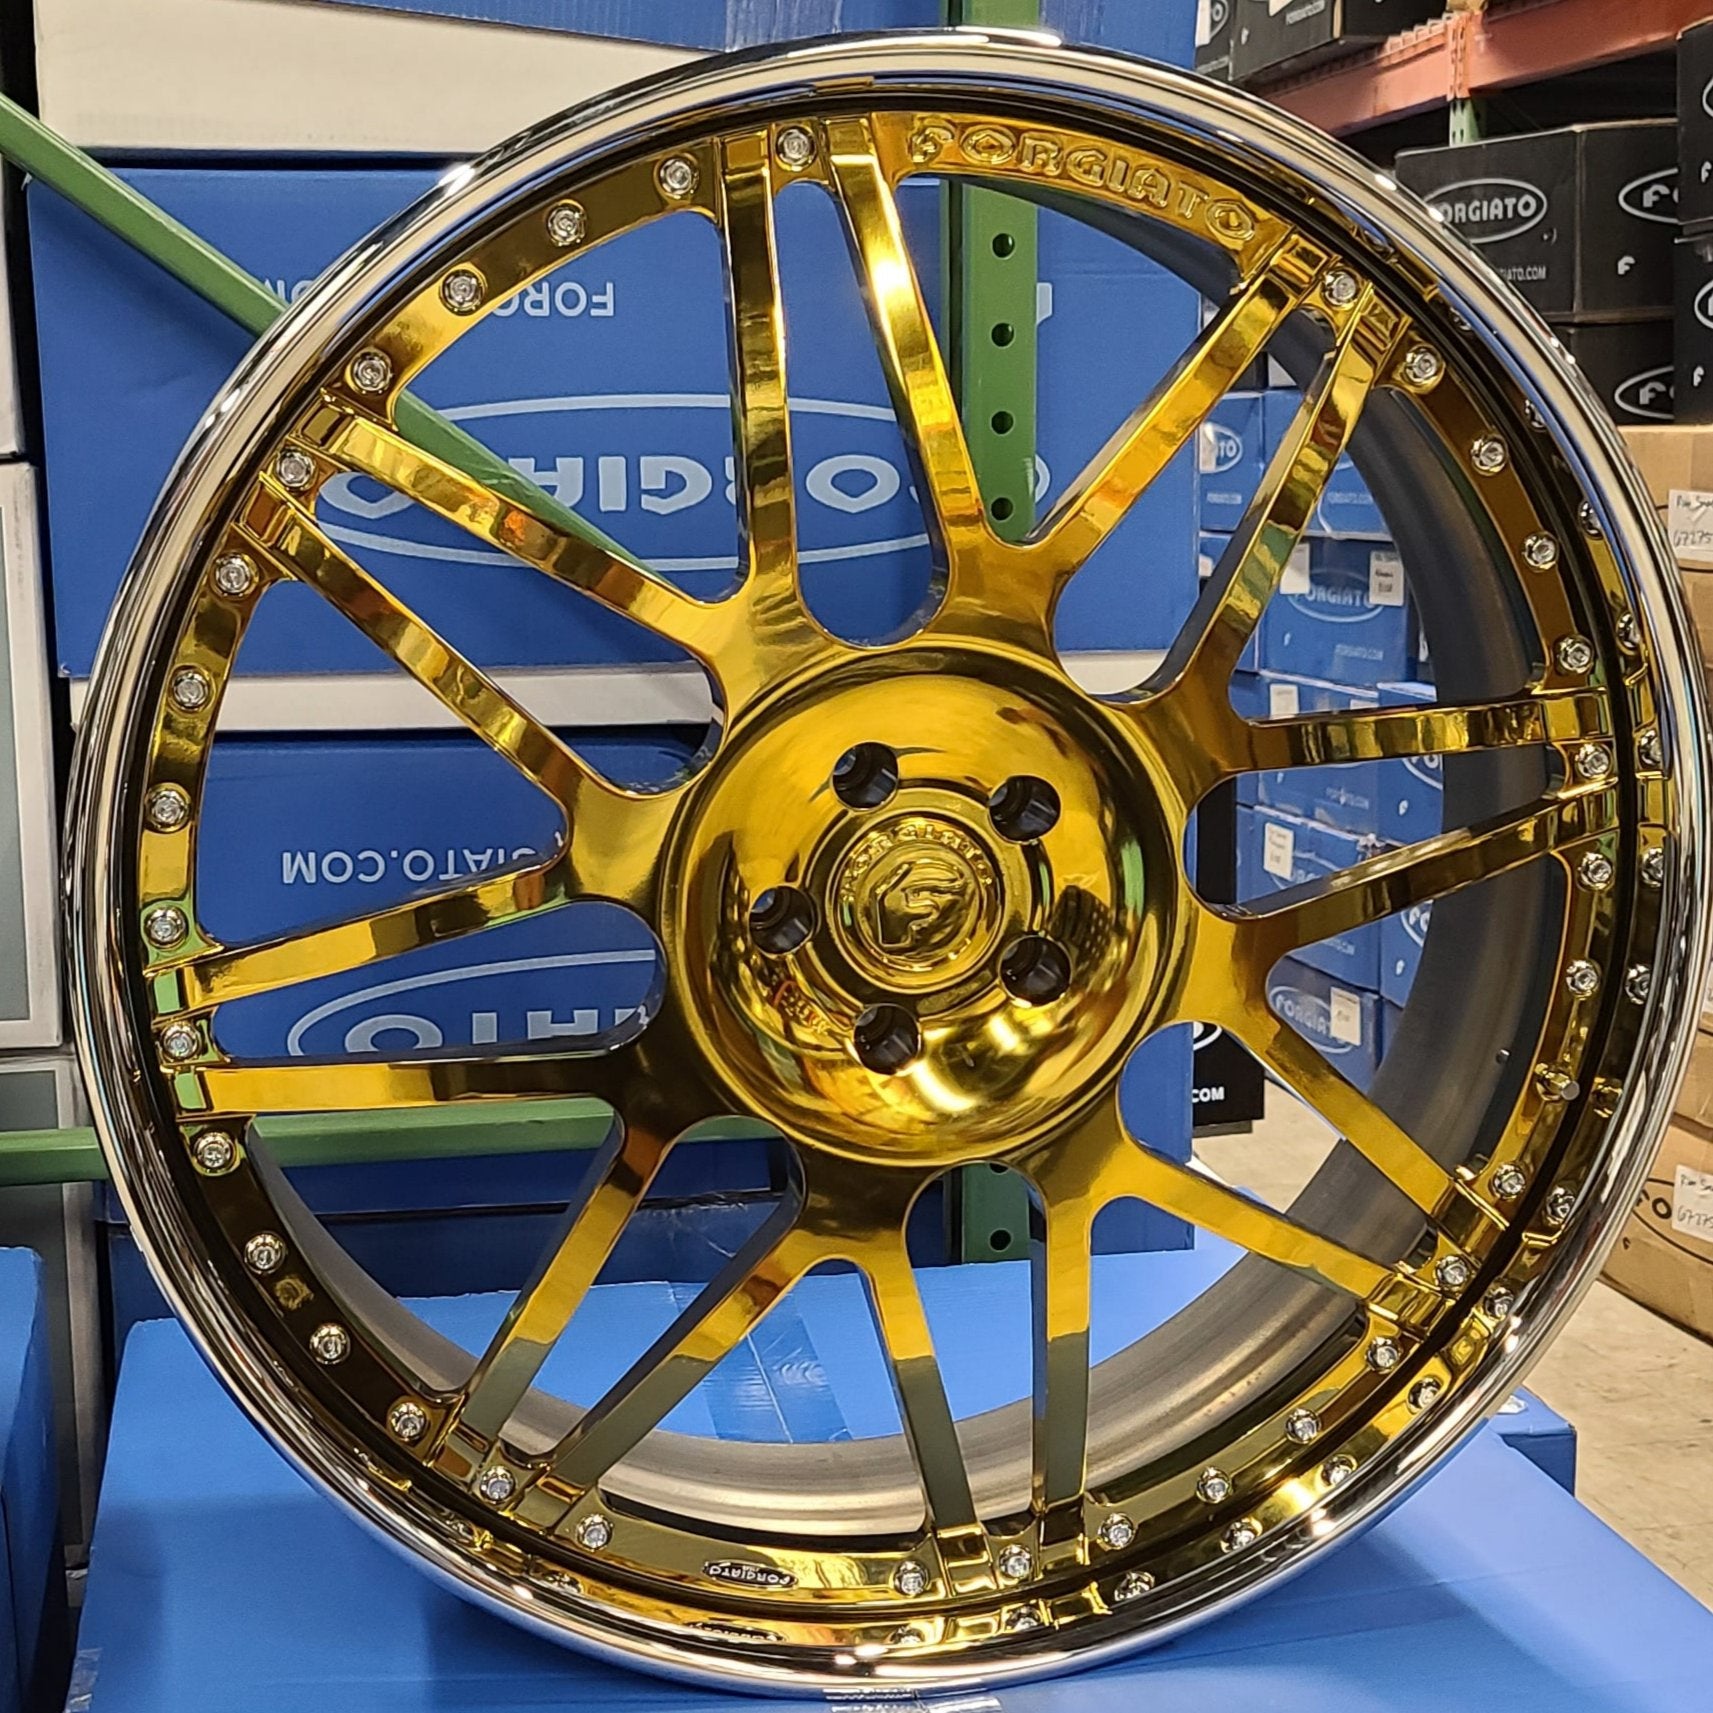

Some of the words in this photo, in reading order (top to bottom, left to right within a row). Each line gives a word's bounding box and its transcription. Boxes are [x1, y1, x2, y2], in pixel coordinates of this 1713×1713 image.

[911, 113, 1257, 240] FORGIATO
[1436, 194, 1538, 223] ORGIATO
[709, 1563, 792, 1586] FORGIATO
